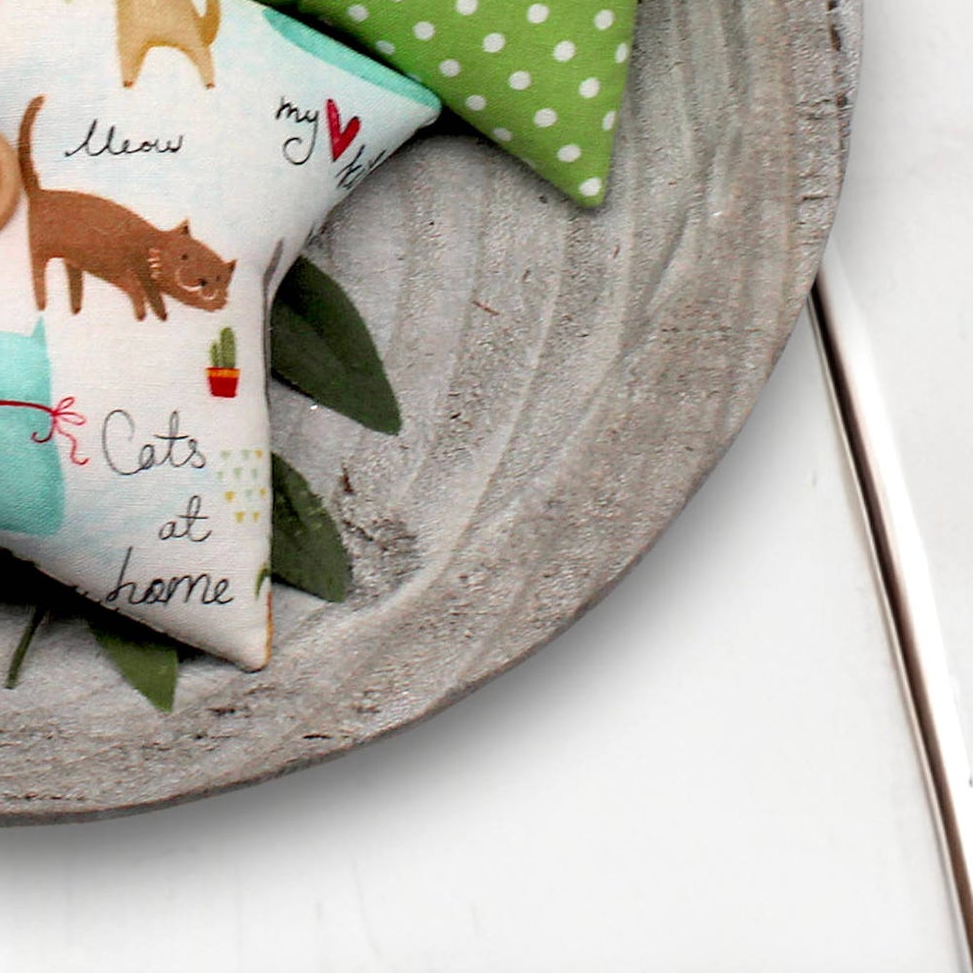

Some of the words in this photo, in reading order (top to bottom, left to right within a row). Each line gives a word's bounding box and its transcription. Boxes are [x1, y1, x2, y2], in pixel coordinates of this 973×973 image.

[64, 118, 183, 157] Meow
[275, 97, 320, 165] my
[102, 409, 207, 476] Cats
[158, 495, 212, 543] at
[106, 546, 234, 605] home
